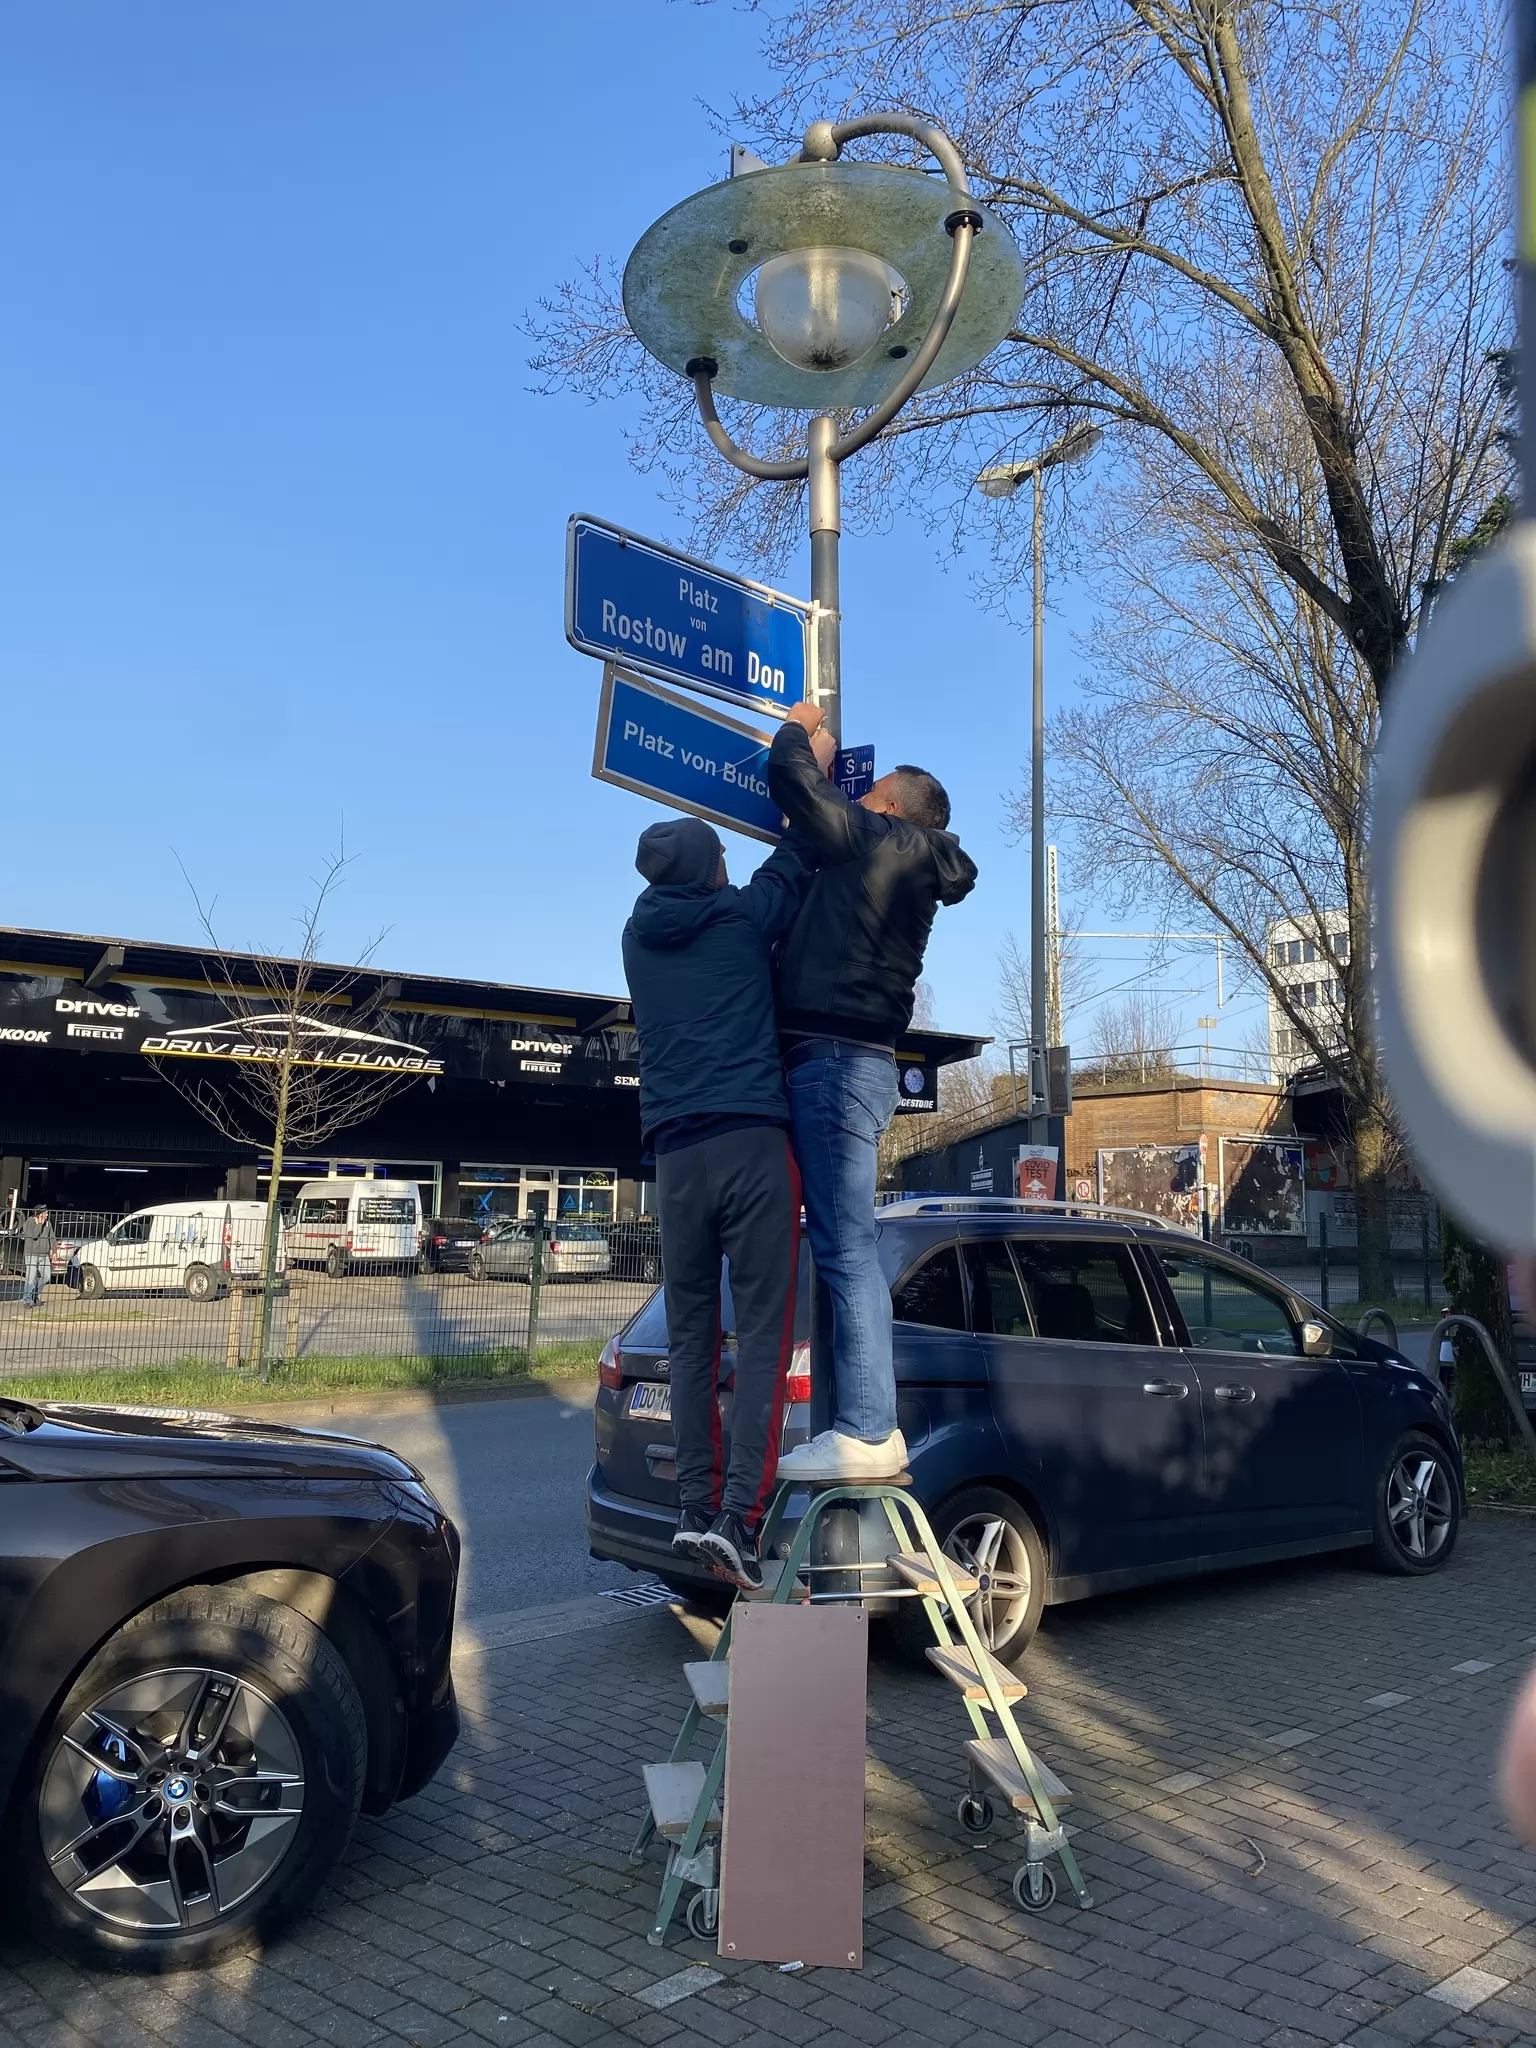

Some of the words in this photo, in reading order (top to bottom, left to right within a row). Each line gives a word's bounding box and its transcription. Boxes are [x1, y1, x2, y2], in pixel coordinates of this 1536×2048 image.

[679, 578, 719, 614] Platz
[689, 616, 707, 632] von
[602, 599, 687, 659] Rostow
[701, 644, 733, 676] am
[747, 651, 785, 694] Don
[623, 720, 674, 759] Platz
[680, 748, 717, 777] von
[845, 758, 855, 775] S
[0, 1027, 52, 1043] KOOK
[67, 1023, 124, 1040] PIRELLI
[143, 1036, 302, 1060] DRIVERS
[313, 1050, 446, 1071] LOUNGE
[520, 1059, 562, 1074] PIRELLI
[899, 1098, 935, 1109] GESTONE
[1024, 1160, 1050, 1169] COVID
[1025, 1168, 1050, 1179] TEST
[639, 1387, 656, 1410] DO
